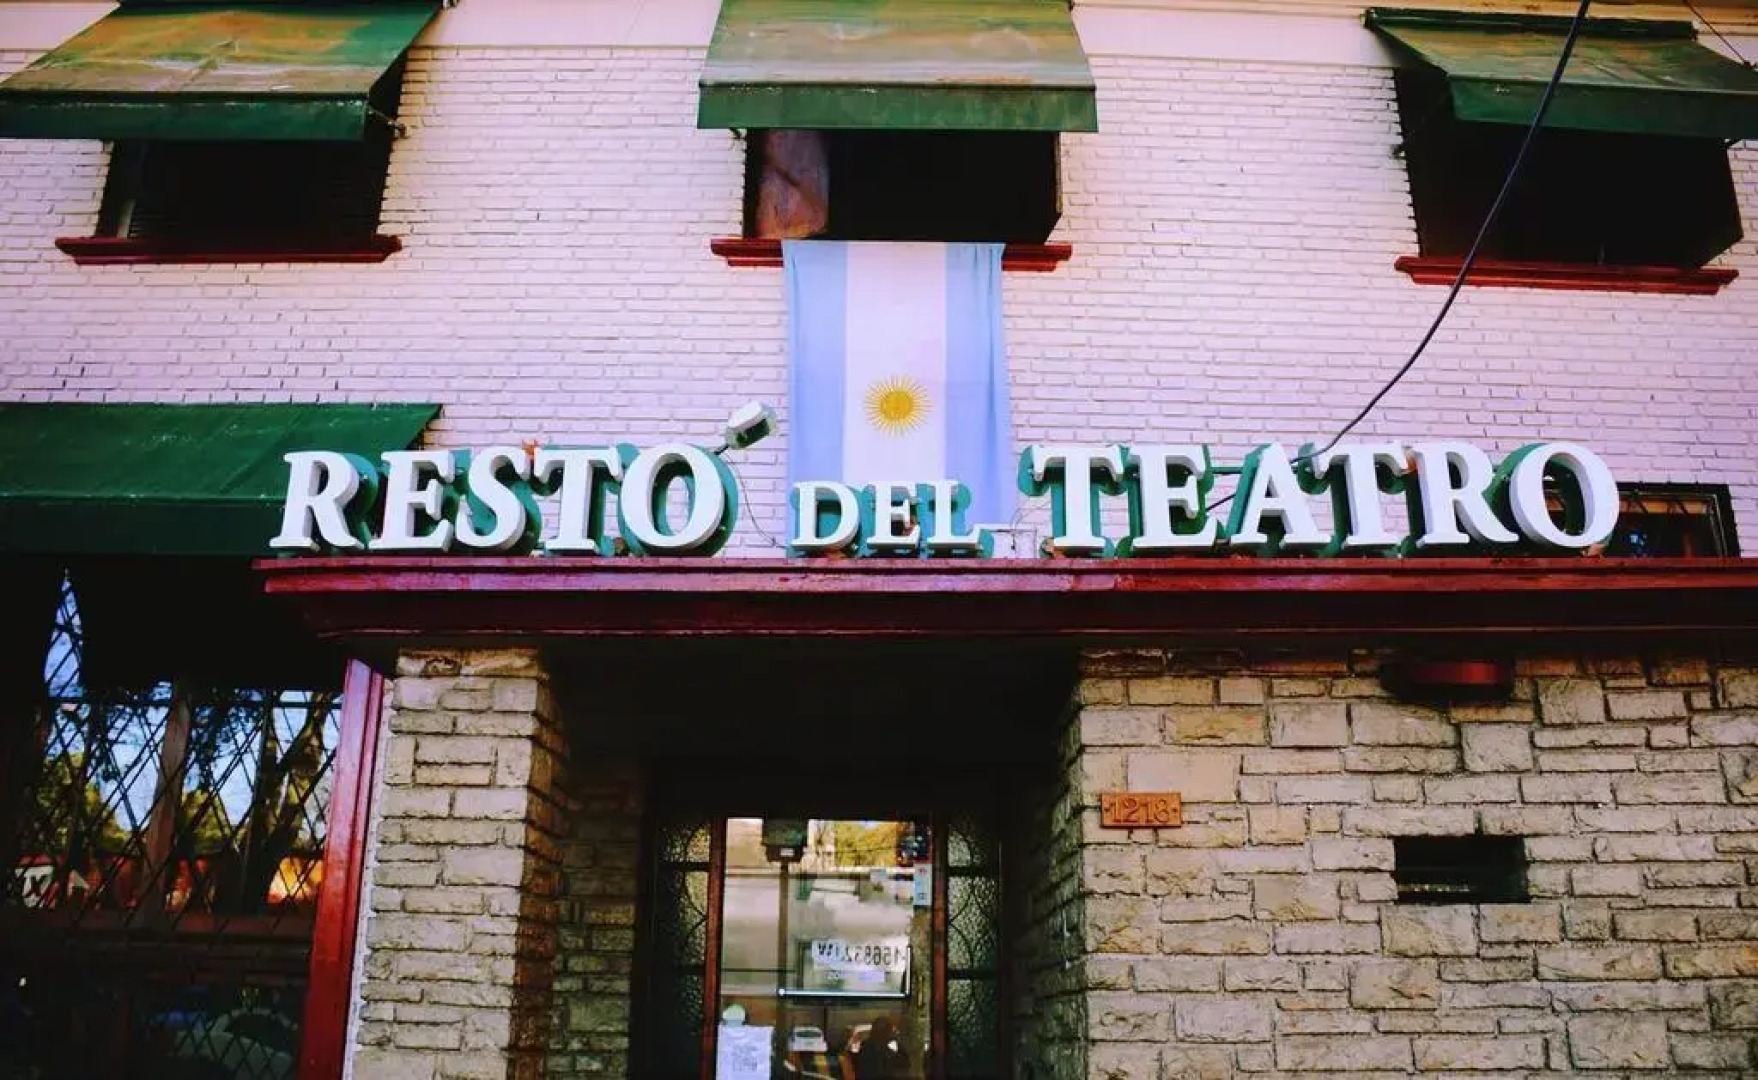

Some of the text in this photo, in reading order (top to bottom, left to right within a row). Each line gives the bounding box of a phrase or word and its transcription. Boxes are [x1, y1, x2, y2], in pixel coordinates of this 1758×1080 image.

[269, 442, 1620, 552] RESTO DEL TEATRO
[1111, 797, 1170, 824] 1218
